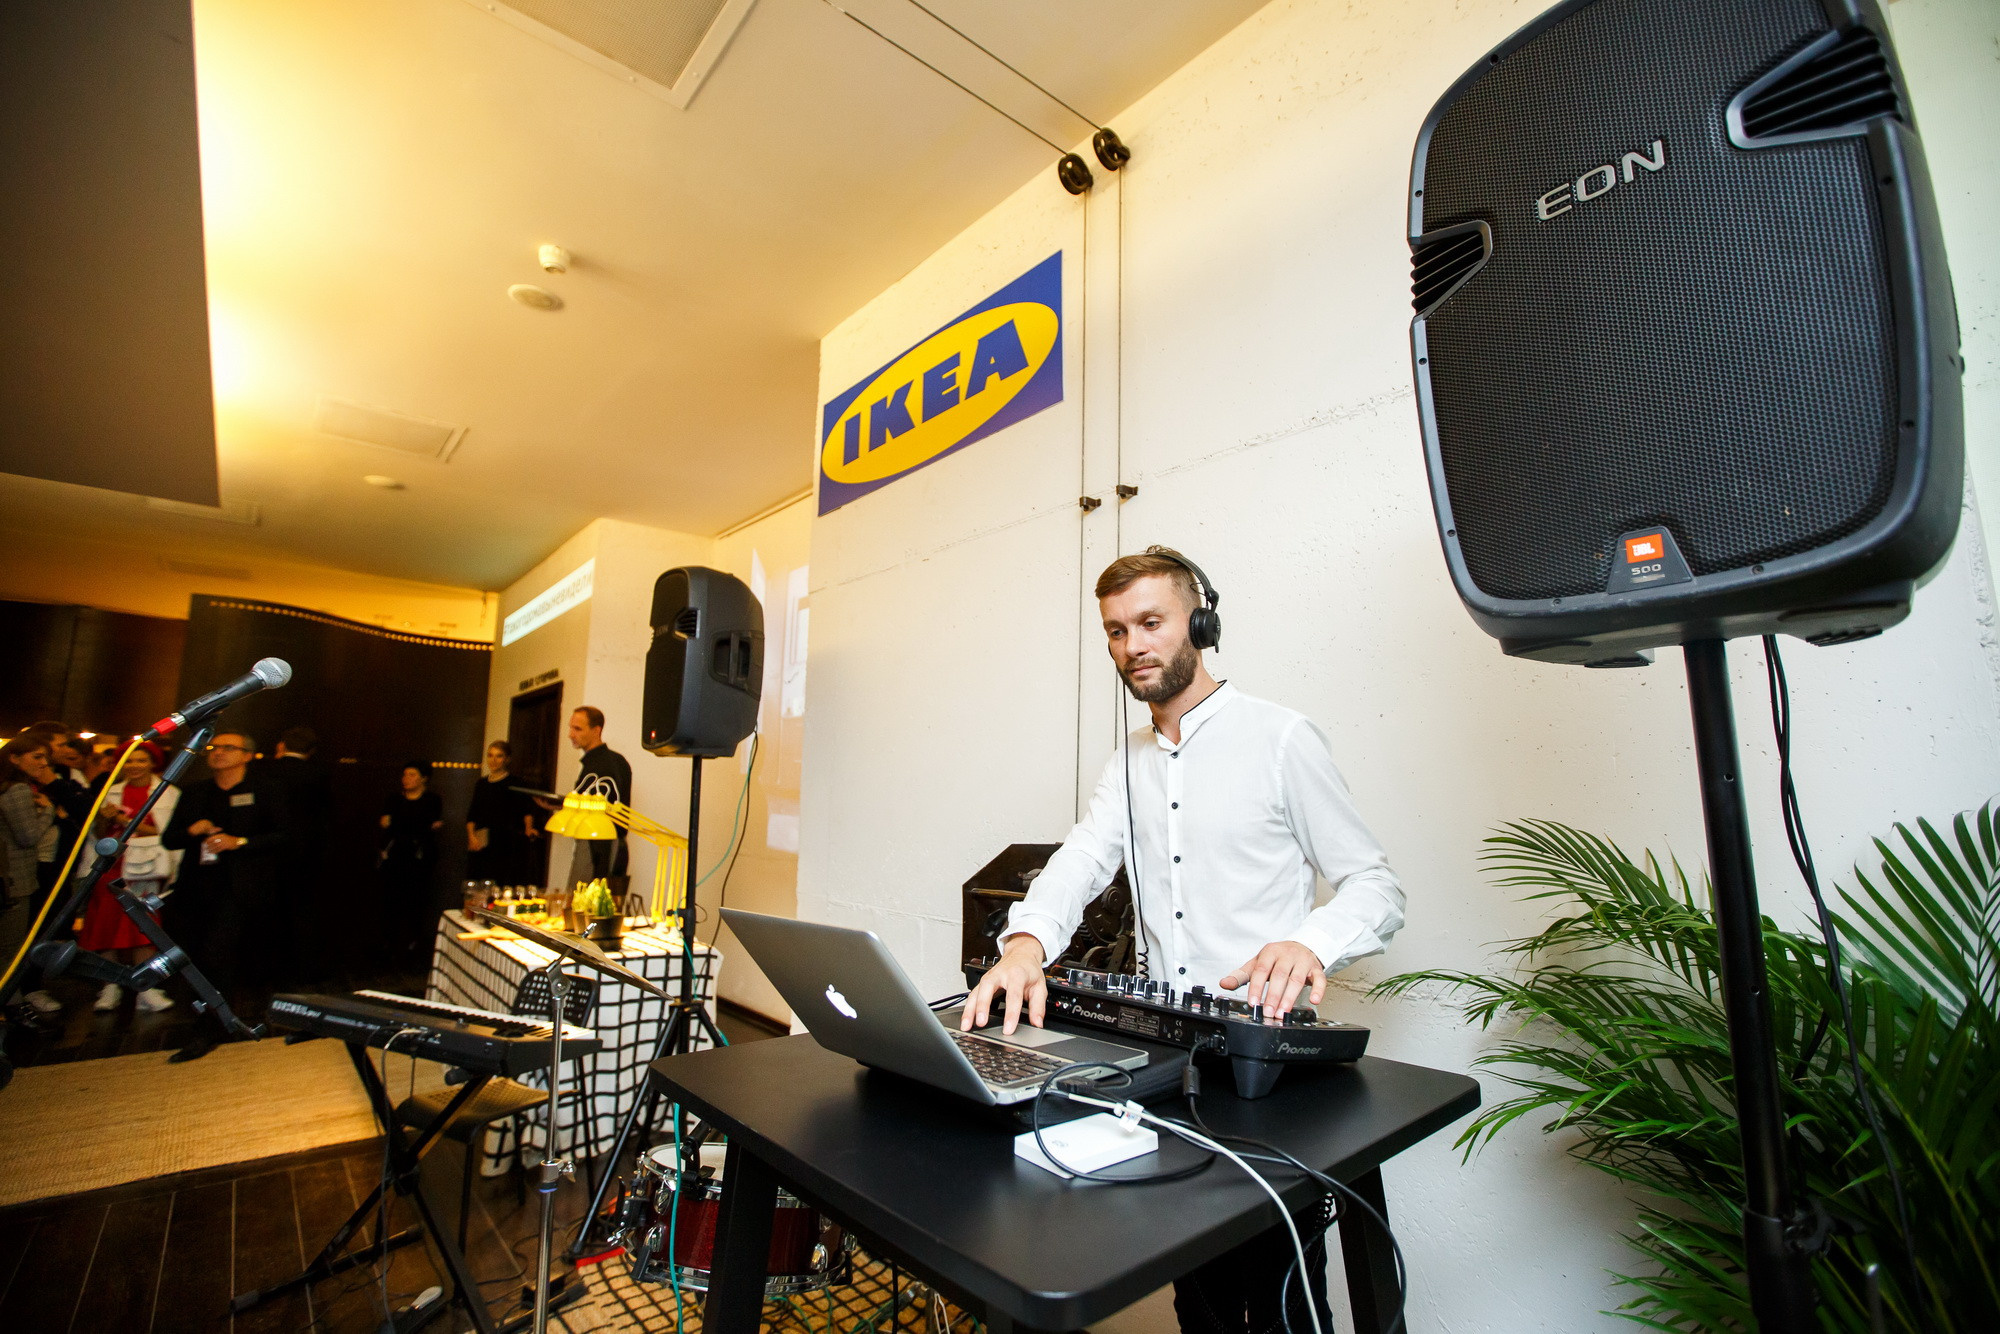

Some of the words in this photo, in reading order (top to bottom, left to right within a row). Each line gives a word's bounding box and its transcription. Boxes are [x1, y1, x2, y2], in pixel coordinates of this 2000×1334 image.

[1537, 139, 1666, 221] EON
[843, 318, 1029, 466] IKEA
[1632, 542, 1656, 557] JBL
[1631, 563, 1662, 576] 500
[1071, 1004, 1118, 1023] Pioneer
[1277, 1042, 1322, 1055] Pioneer
